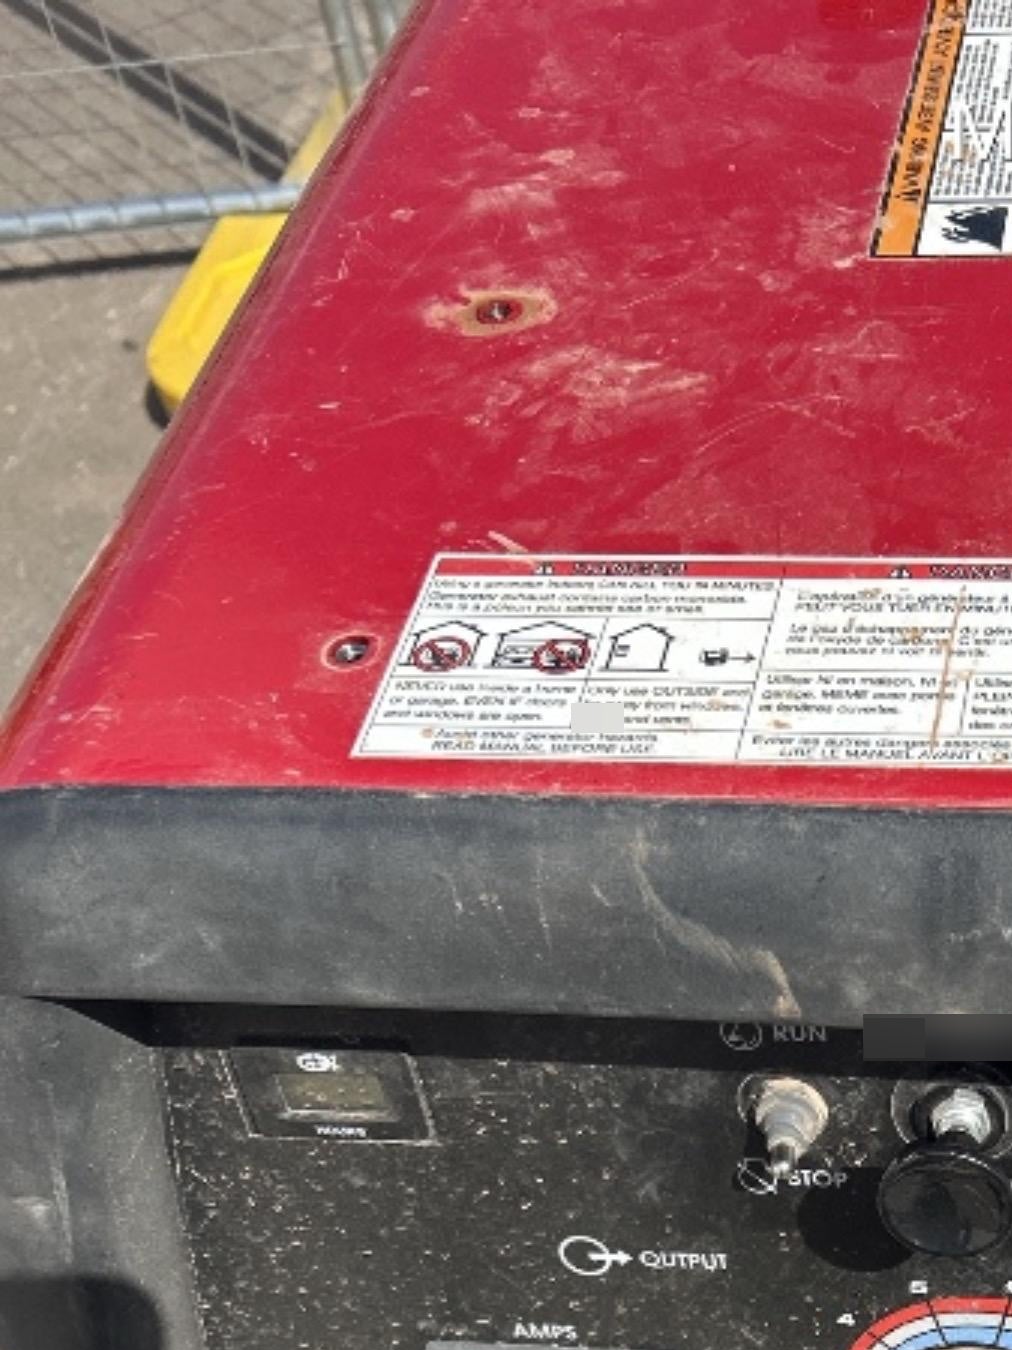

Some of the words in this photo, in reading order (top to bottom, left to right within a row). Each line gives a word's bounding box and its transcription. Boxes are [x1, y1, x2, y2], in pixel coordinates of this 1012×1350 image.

[772, 1024, 828, 1043] RUN
[787, 1168, 850, 1189] STOP
[638, 1250, 728, 1272] OUTPUT
[836, 1312, 856, 1327] 4
[513, 1323, 579, 1341] AMPS
